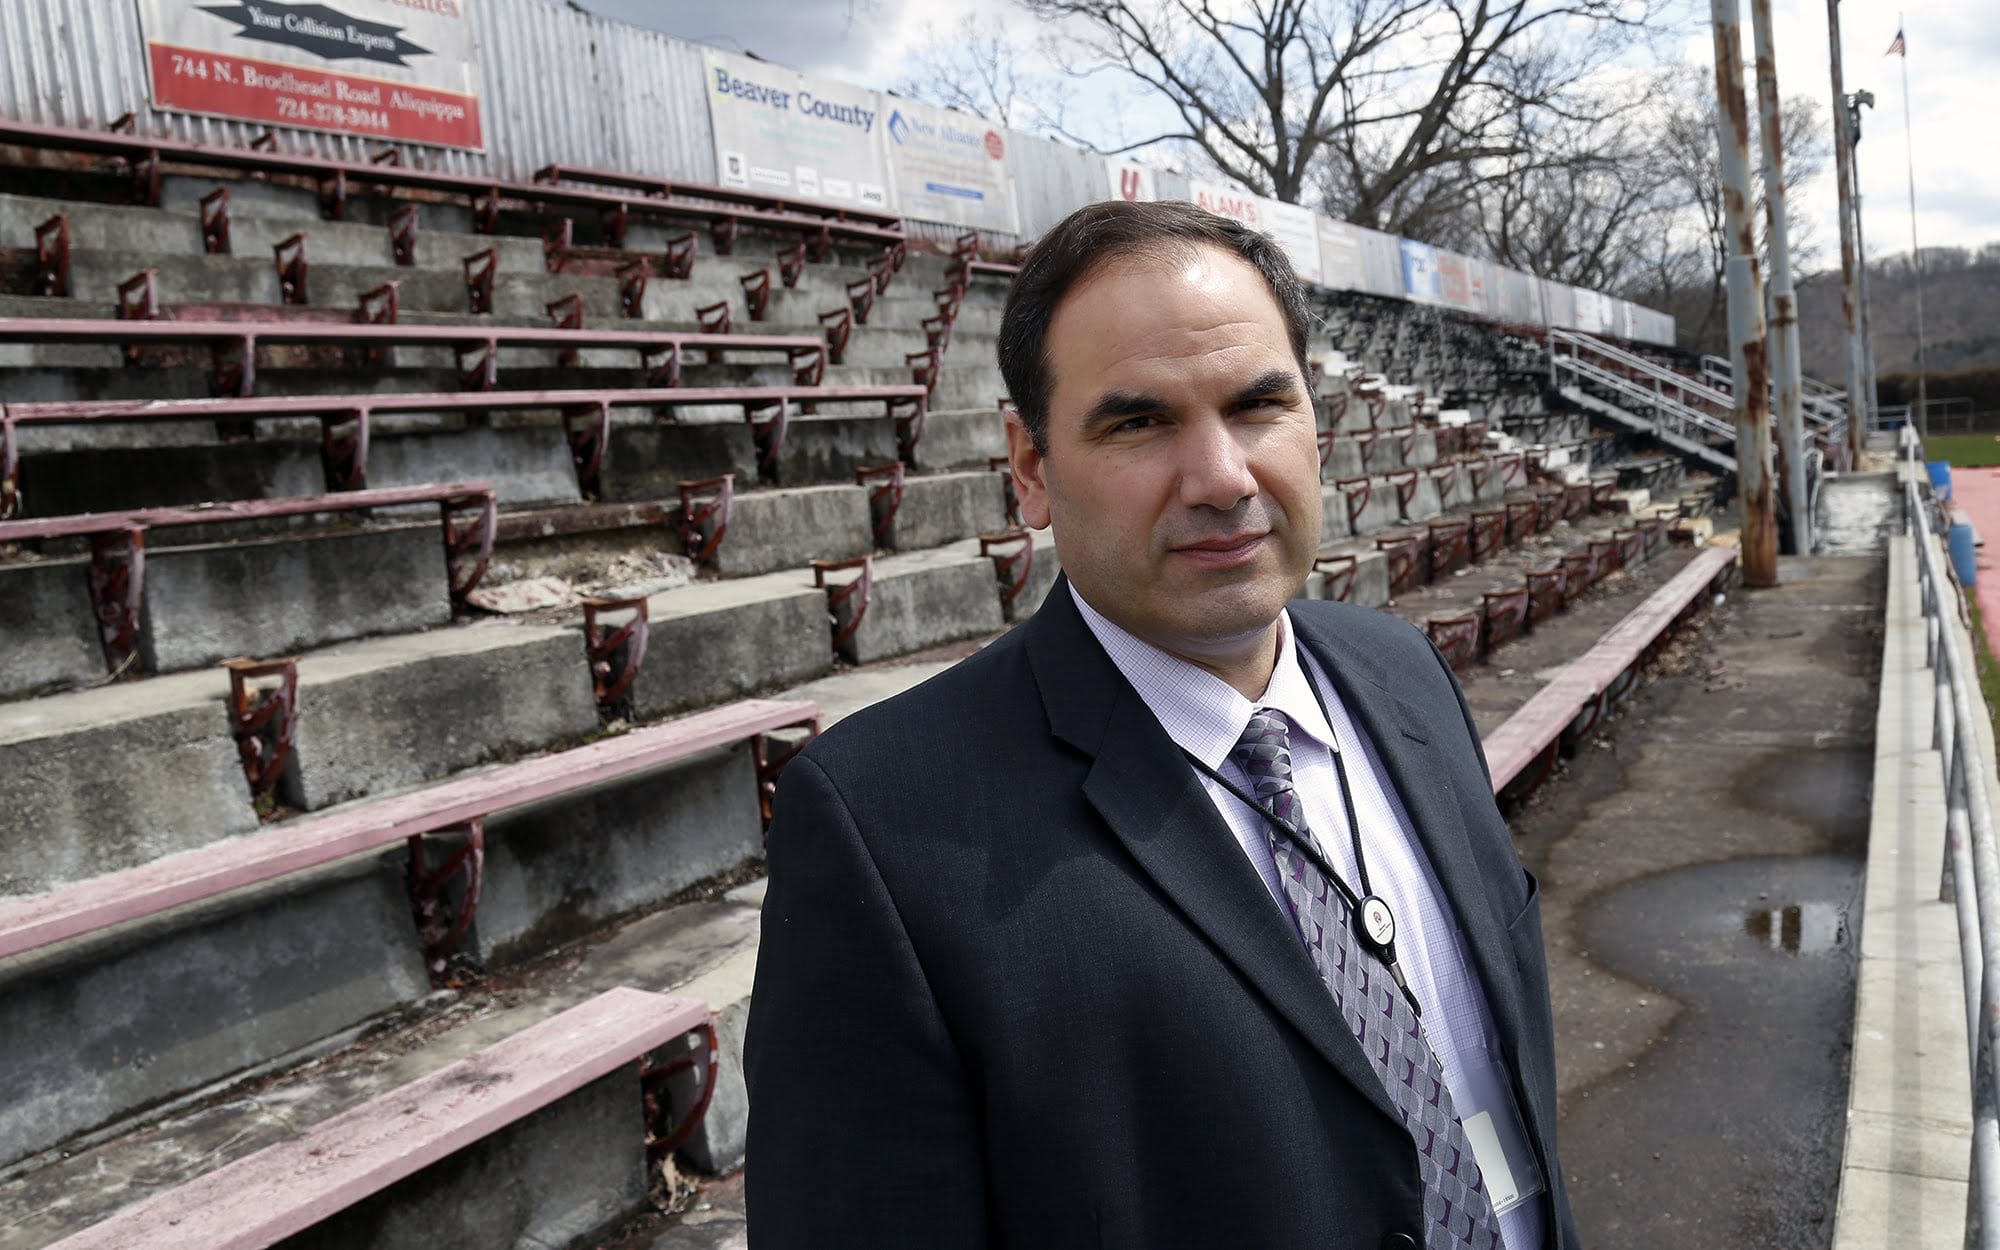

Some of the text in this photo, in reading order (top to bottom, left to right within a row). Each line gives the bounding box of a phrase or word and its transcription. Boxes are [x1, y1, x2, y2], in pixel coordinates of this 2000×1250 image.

[248, 6, 396, 51] Your Collision Experts
[171, 54, 465, 122] 744 N. Brodhead Road Aliquippa
[715, 67, 874, 133] Beaver County
